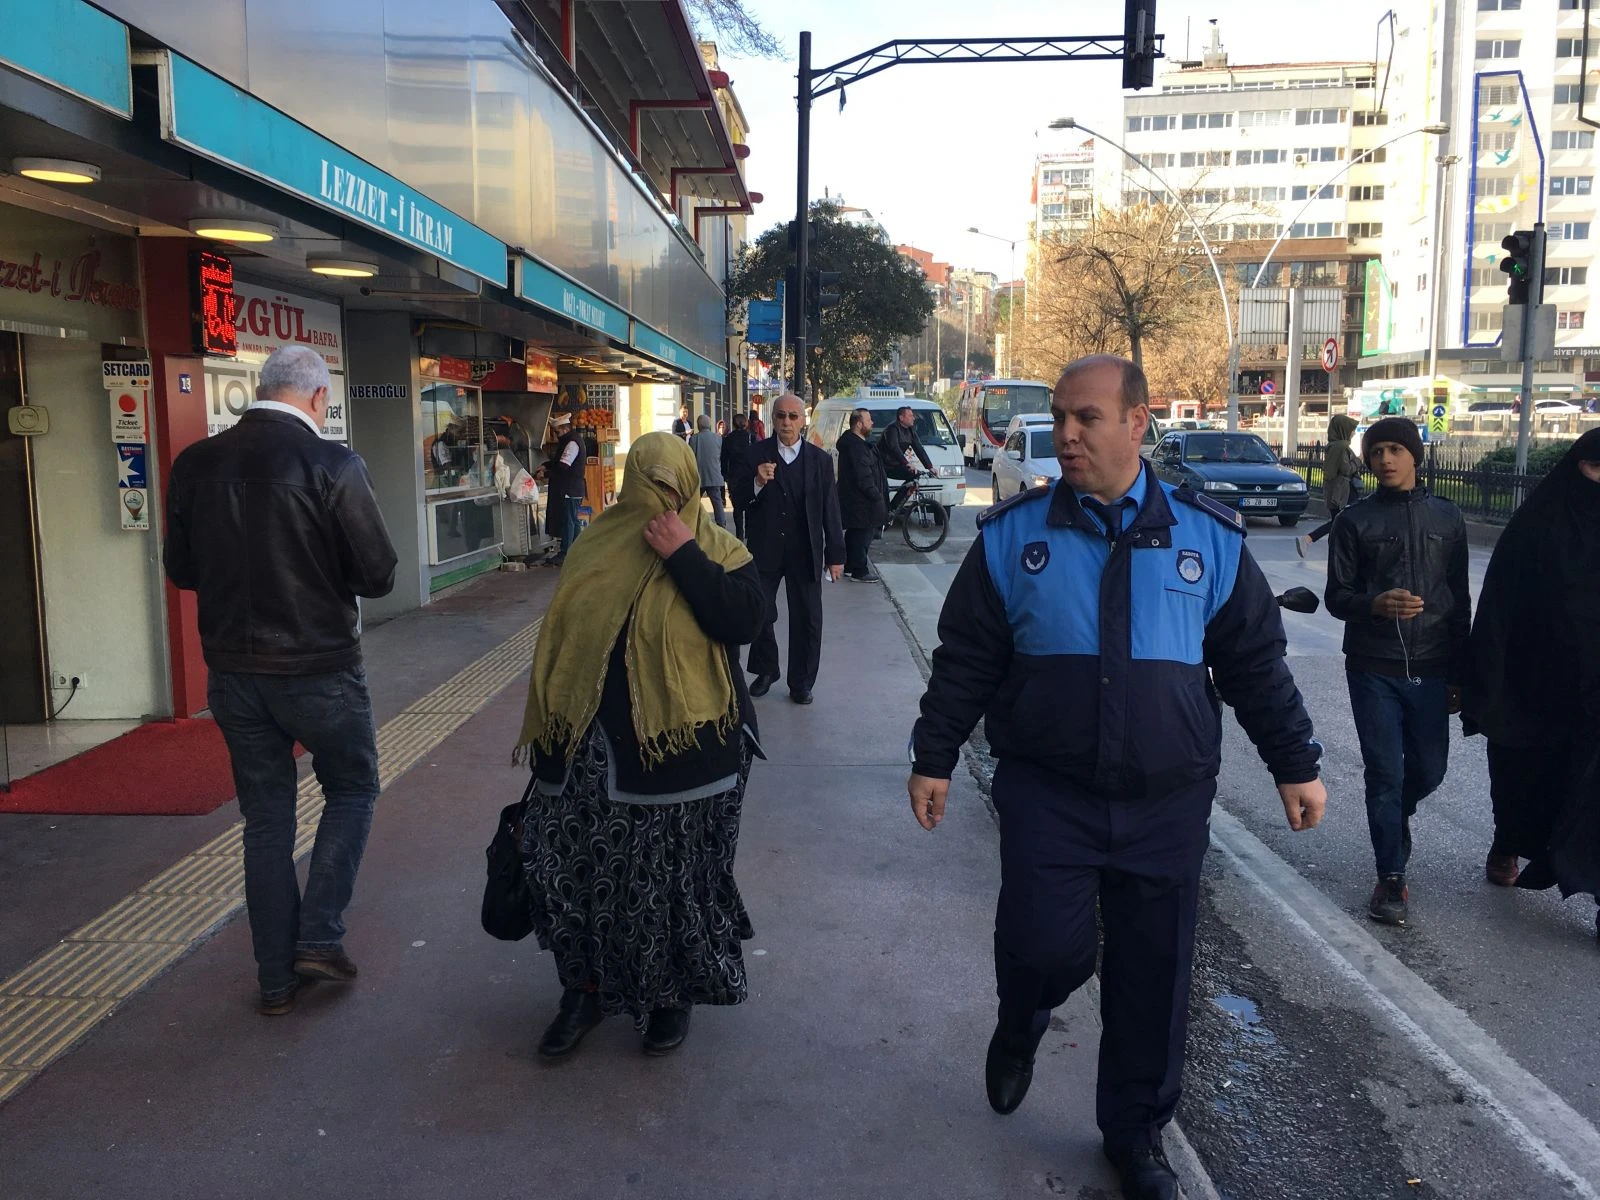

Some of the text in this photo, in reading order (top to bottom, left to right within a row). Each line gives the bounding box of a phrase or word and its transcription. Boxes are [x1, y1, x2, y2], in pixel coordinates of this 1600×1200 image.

[410, 201, 453, 256] İKRAM
[313, 330, 338, 348] BAFRA
[104, 363, 150, 376] SETCARD
[350, 383, 406, 398] NBEROĞLU
